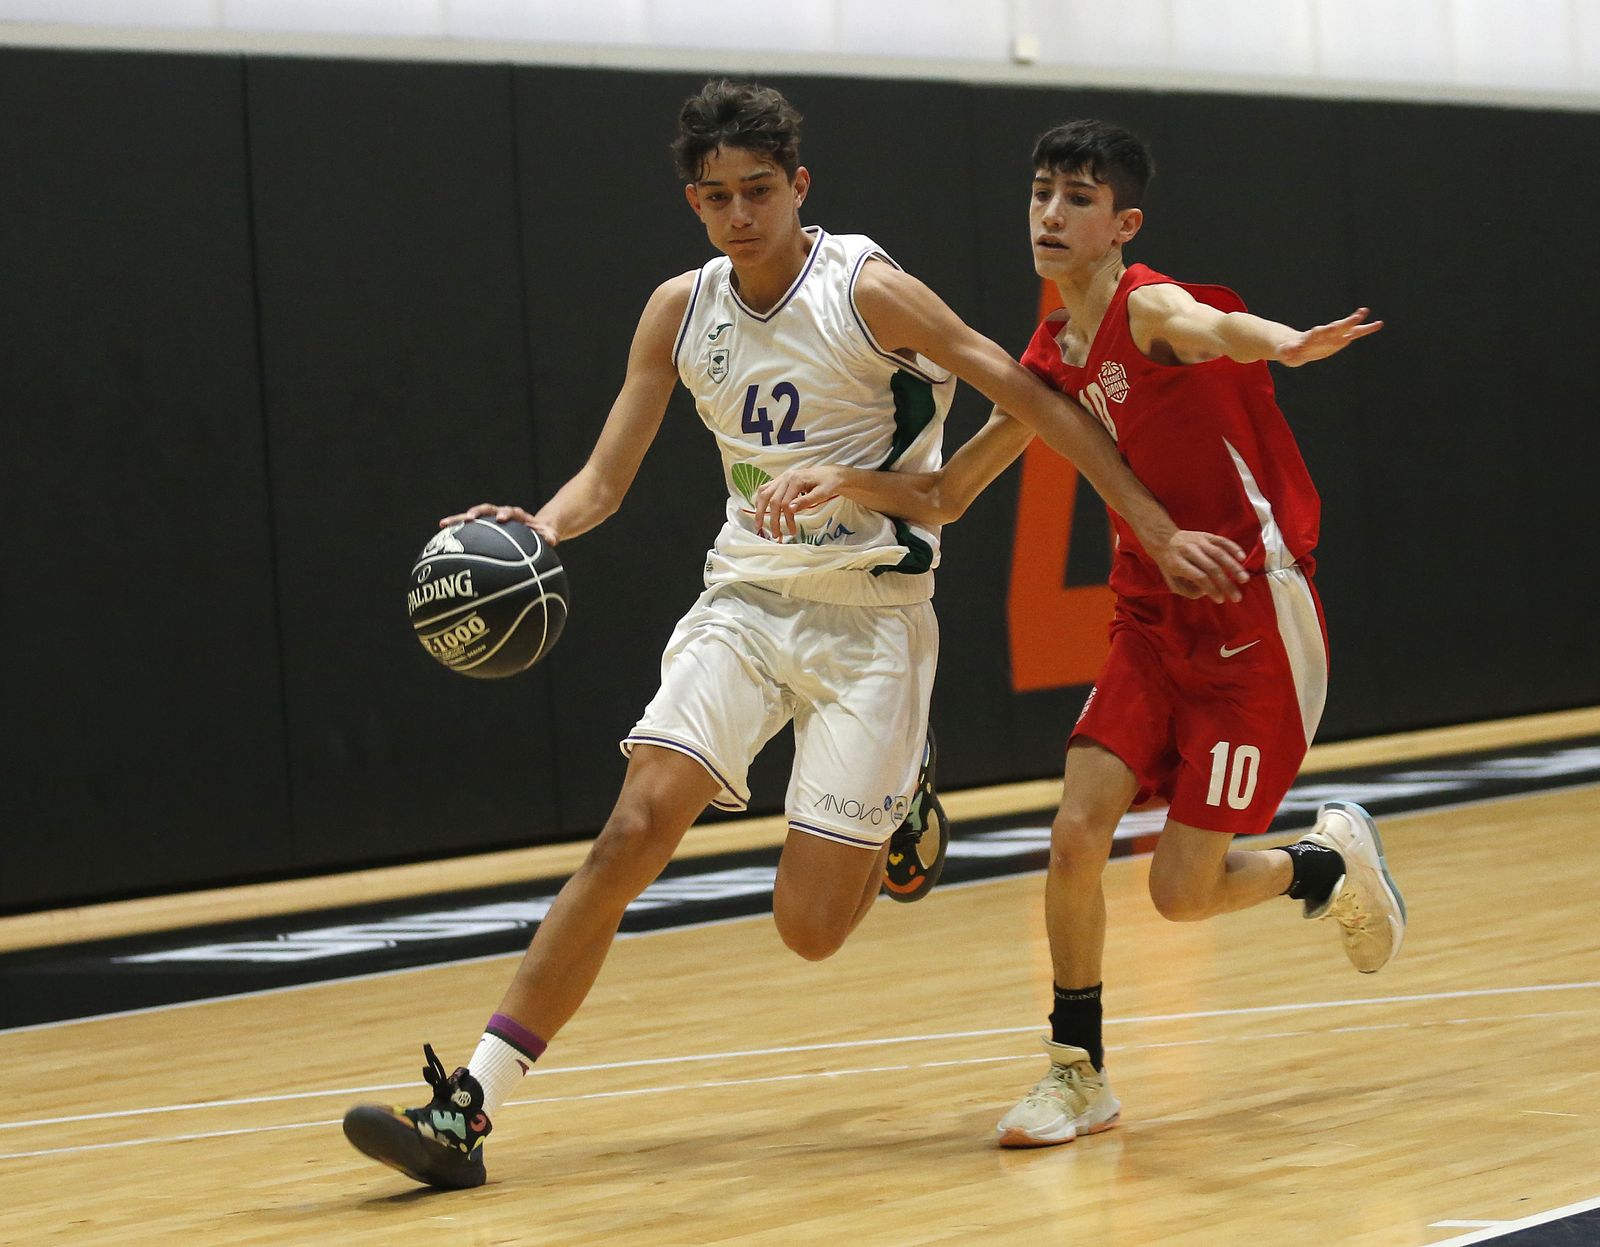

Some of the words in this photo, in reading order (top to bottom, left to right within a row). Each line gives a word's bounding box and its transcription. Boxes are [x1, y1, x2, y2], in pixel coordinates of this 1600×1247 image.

[741, 381, 806, 446] 42
[407, 569, 473, 617] PALDING
[1206, 741, 1261, 810] 10
[814, 793, 883, 826] ANOVO
